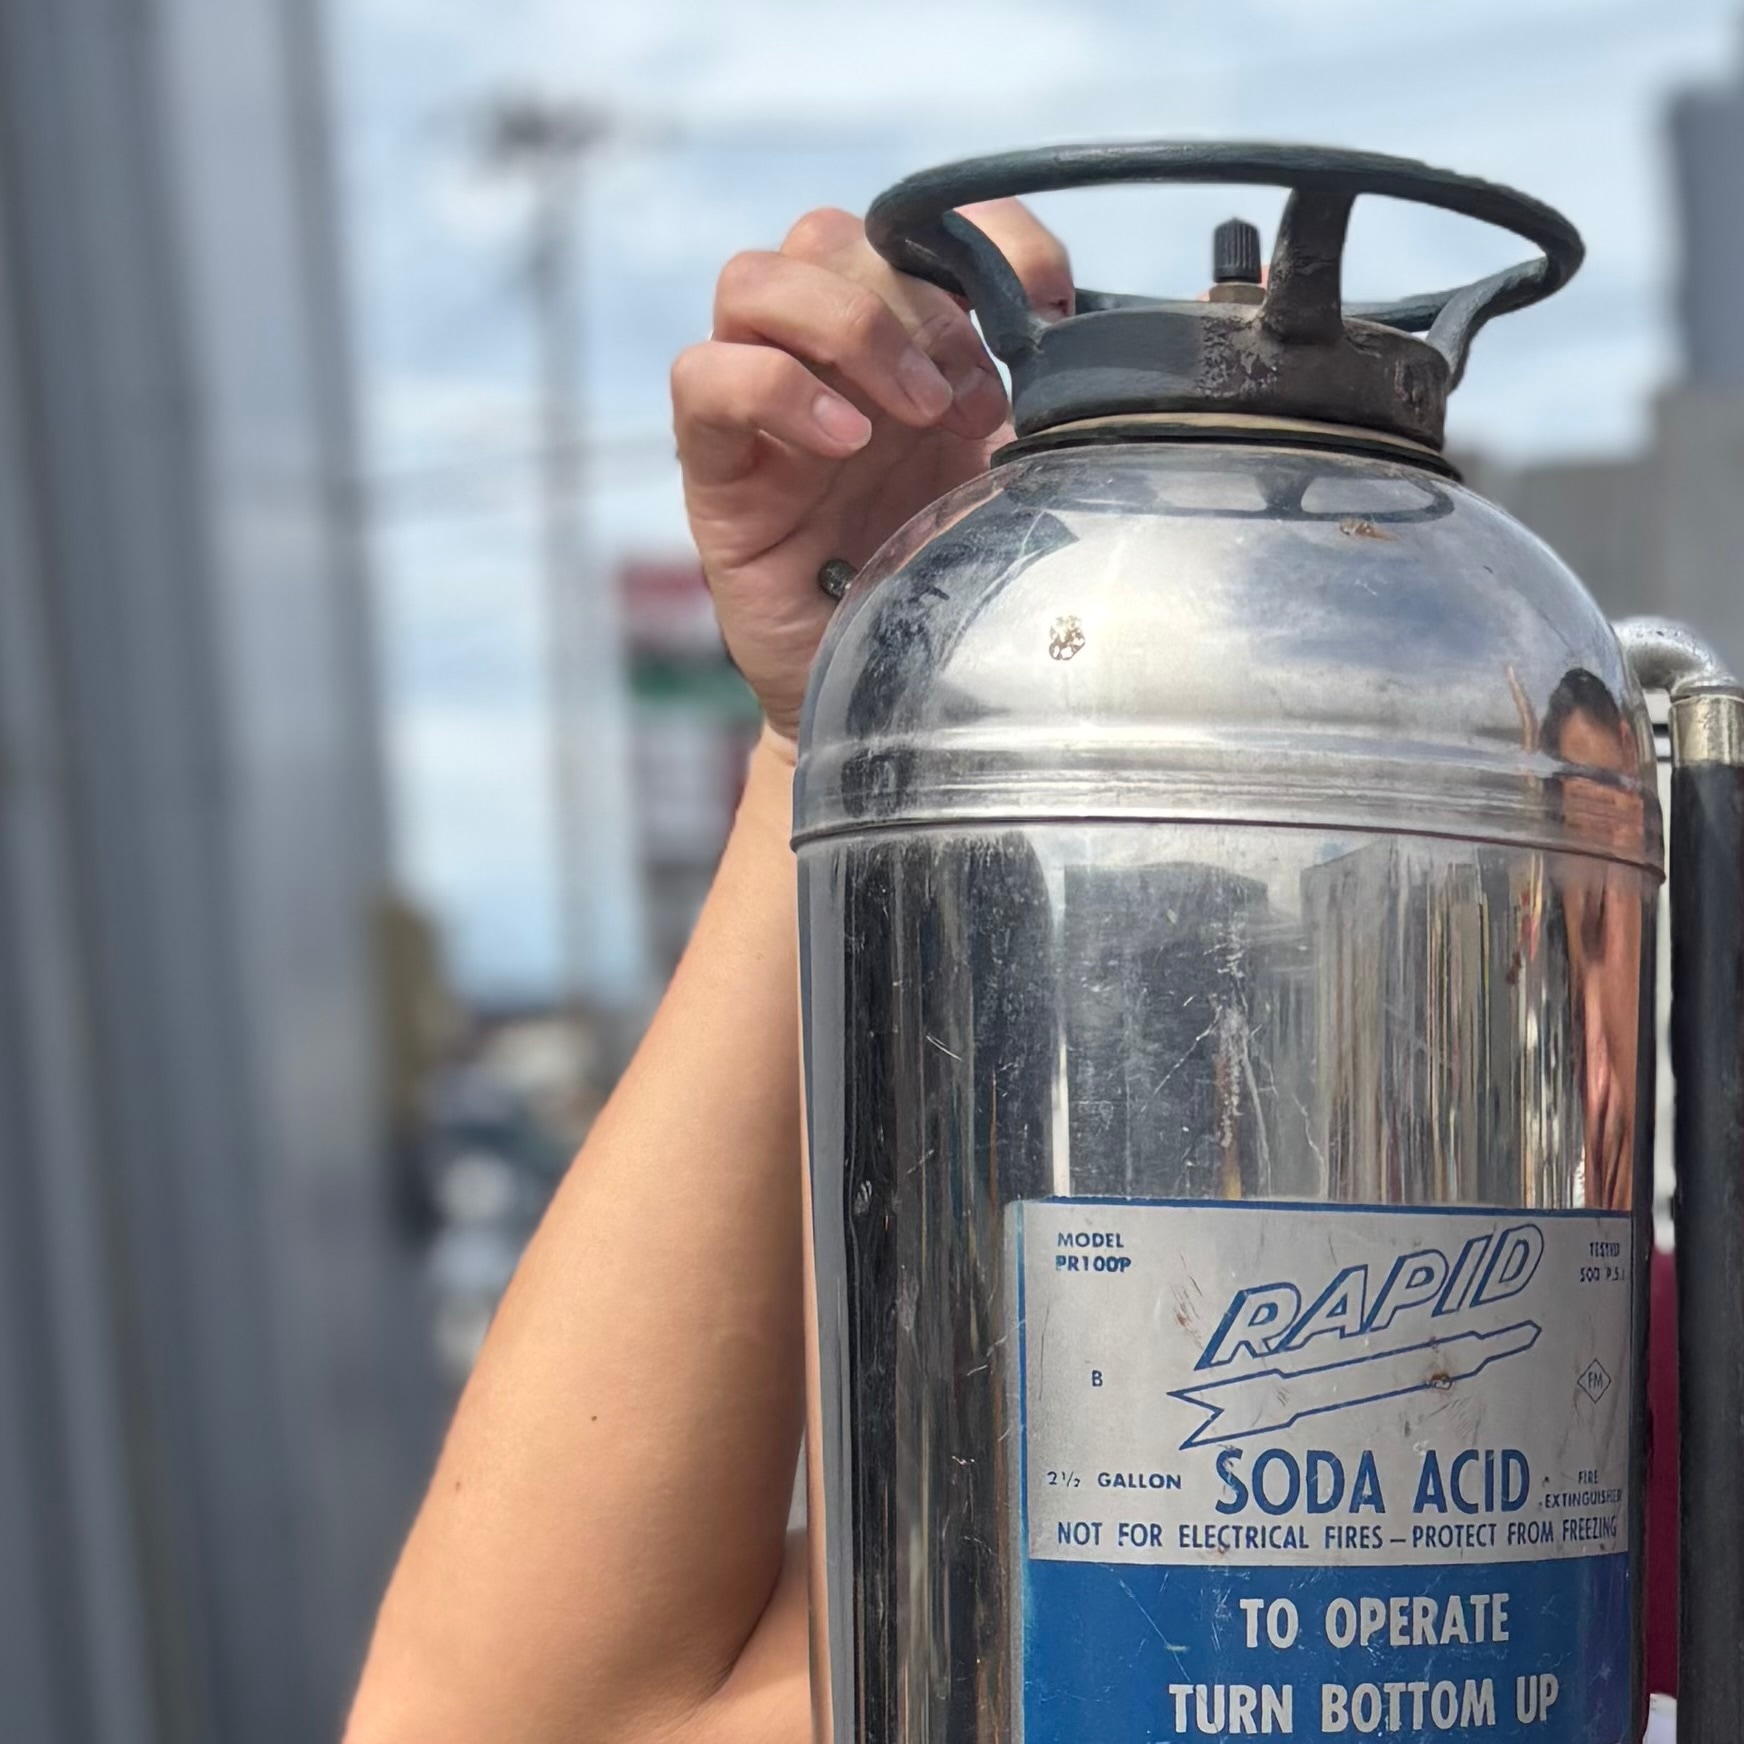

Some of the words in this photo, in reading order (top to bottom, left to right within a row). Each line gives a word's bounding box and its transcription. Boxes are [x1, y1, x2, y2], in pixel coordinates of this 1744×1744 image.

[1058, 1233, 1124, 1248] MODEL
[1194, 1223, 1544, 1370] RAPID
[1092, 1370, 1103, 1387] B
[1588, 1371, 1603, 1389] FM
[1097, 1472, 1182, 1489] GALLON
[1215, 1448, 1386, 1515] SODA
[1413, 1449, 1530, 1514] ACID
[1578, 1469, 1599, 1485] FIRE
[1545, 1488, 1624, 1509] EXTINGUISHER
[1058, 1521, 1103, 1546] NOT
[1118, 1523, 1163, 1548] FOR
[1179, 1525, 1310, 1550] ELECTRICAL
[1325, 1525, 1383, 1550] FIRES
[1412, 1523, 1497, 1548] PROTECT
[1507, 1520, 1554, 1545] FROM
[1562, 1515, 1618, 1543] FREEZING
[1240, 1598, 1299, 1649] TO
[1325, 1593, 1510, 1649] OPERATE
[1168, 1683, 1294, 1734] TURN
[1320, 1679, 1497, 1734] BOTTOM
[1514, 1674, 1560, 1724] UP
